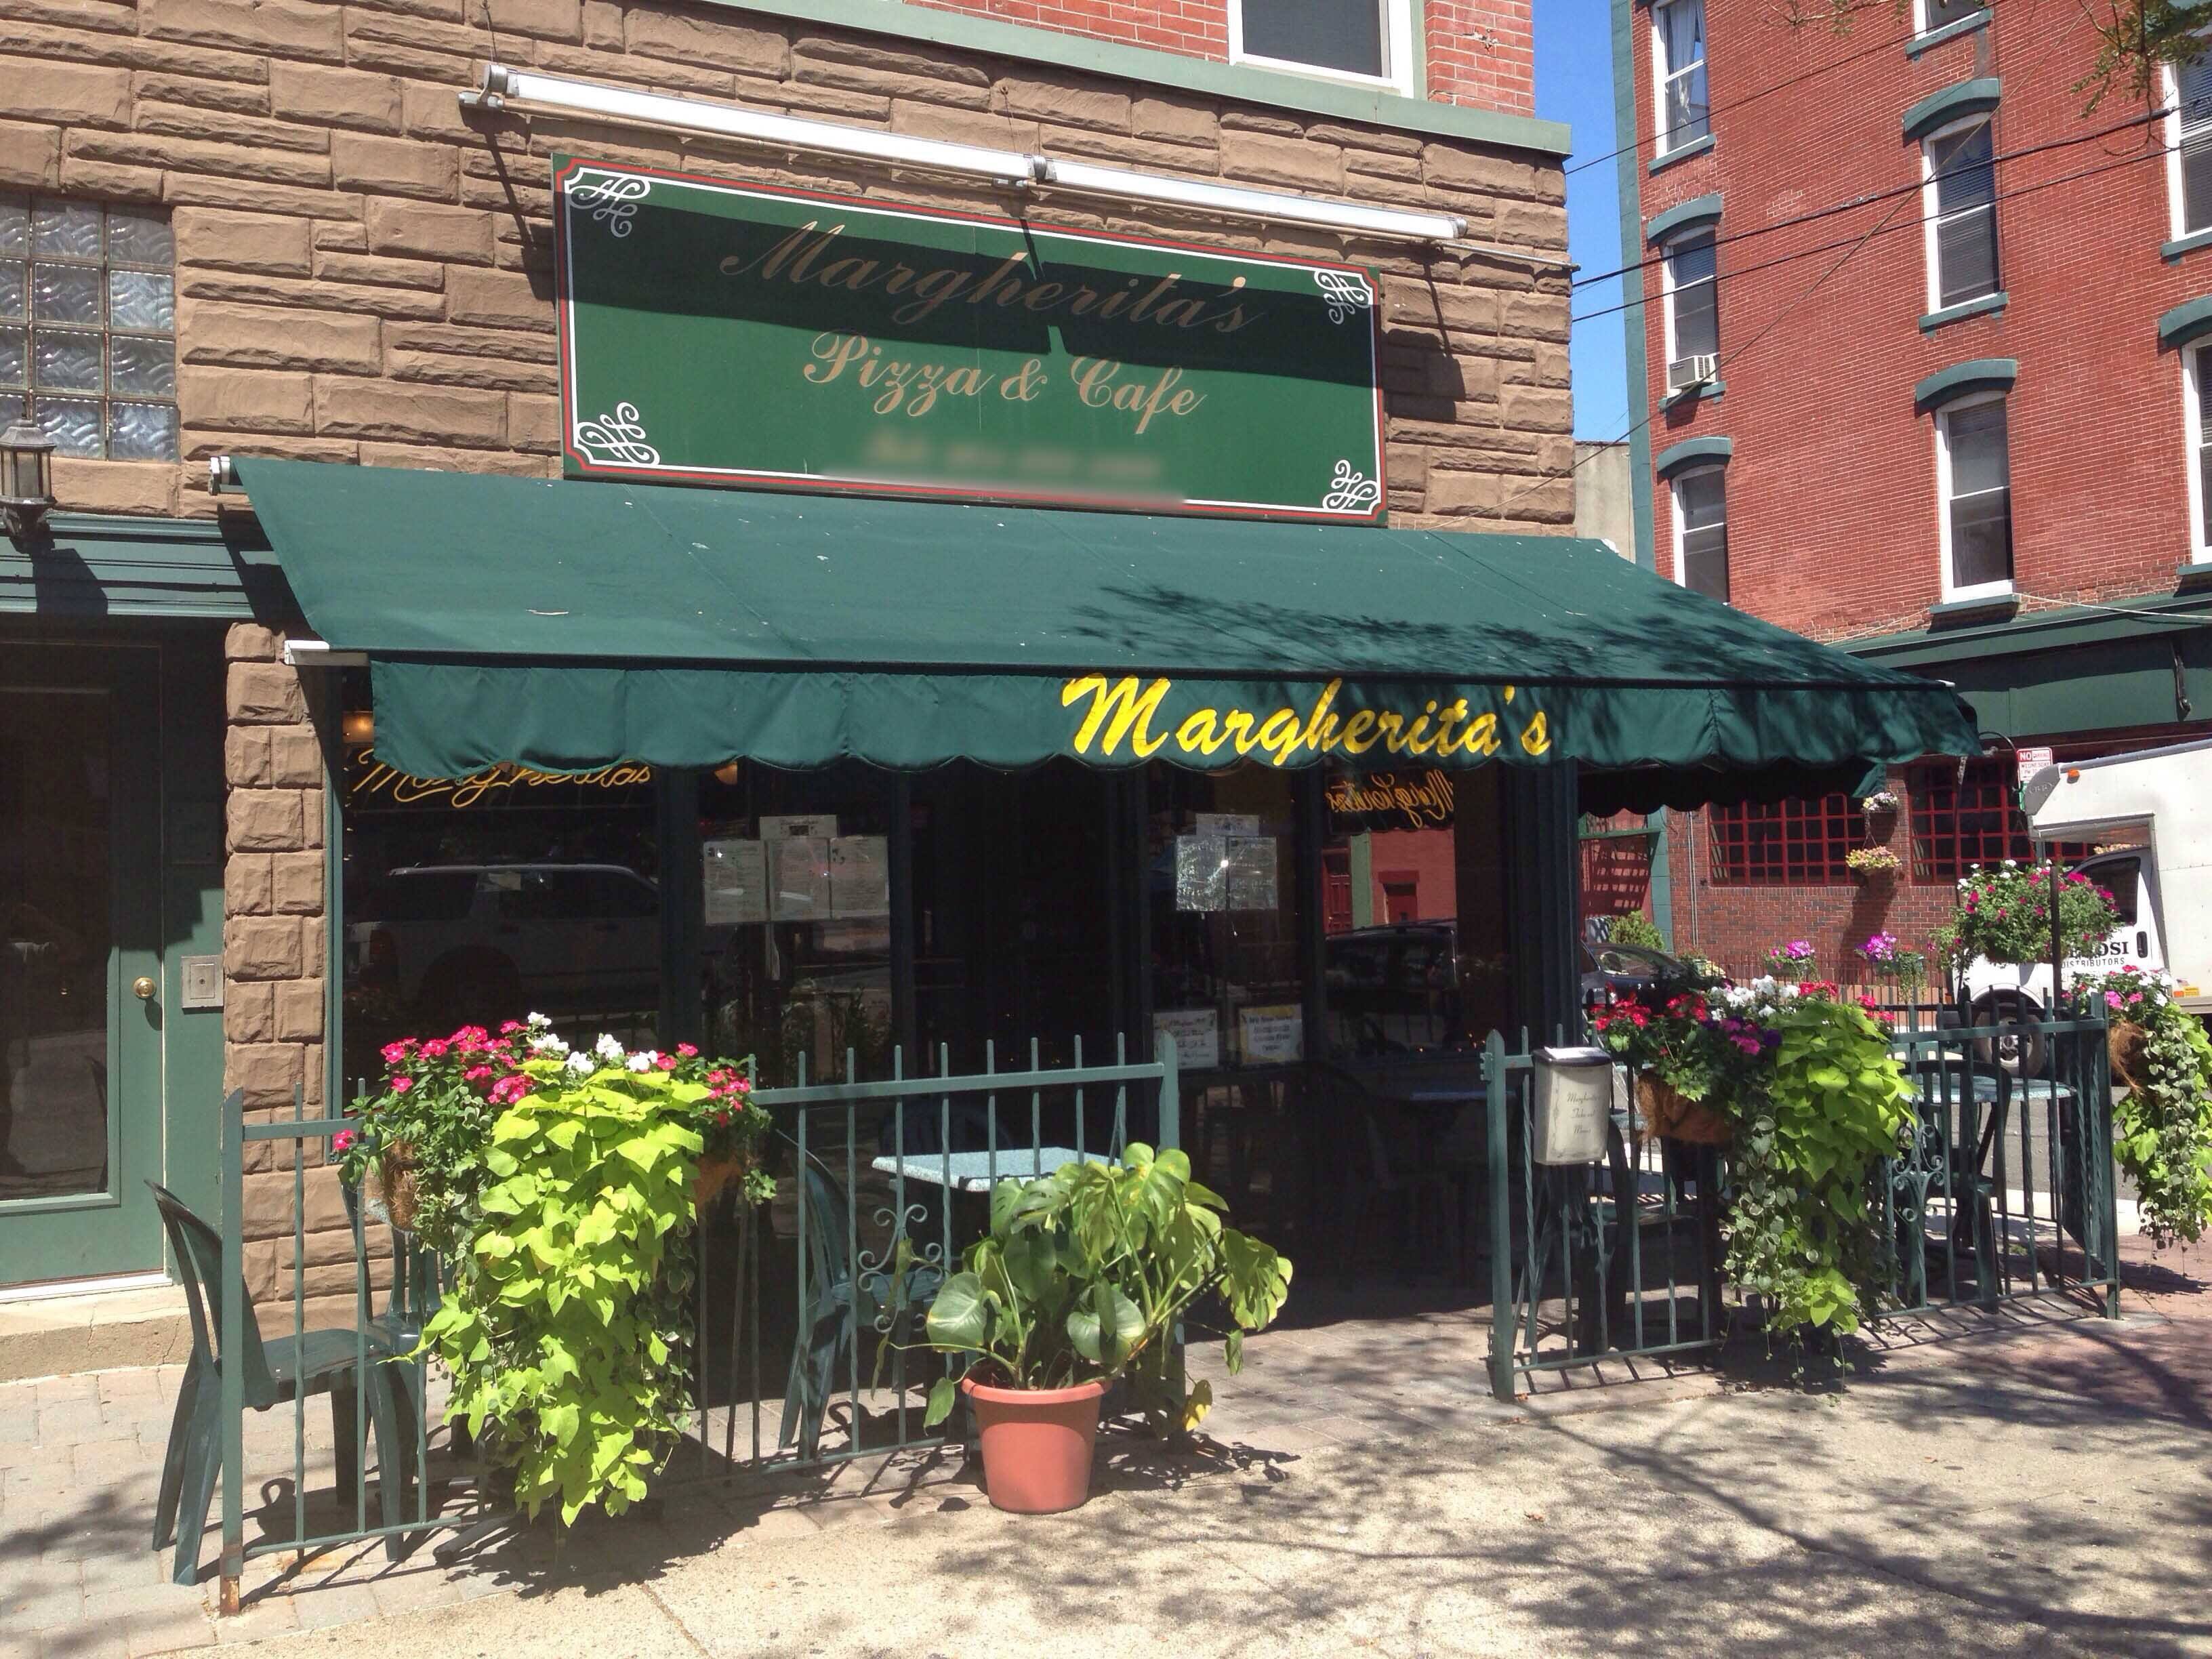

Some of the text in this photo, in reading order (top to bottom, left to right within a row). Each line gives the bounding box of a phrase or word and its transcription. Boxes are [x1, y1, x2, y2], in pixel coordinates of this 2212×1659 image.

[719, 220, 1266, 333] Margherita's
[803, 330, 1208, 434] Pizza & Cafe
[1061, 672, 1553, 767] Margherita's
[2020, 752, 2032, 761] NO
[2062, 958, 2125, 969] DISTRIBUTORS
